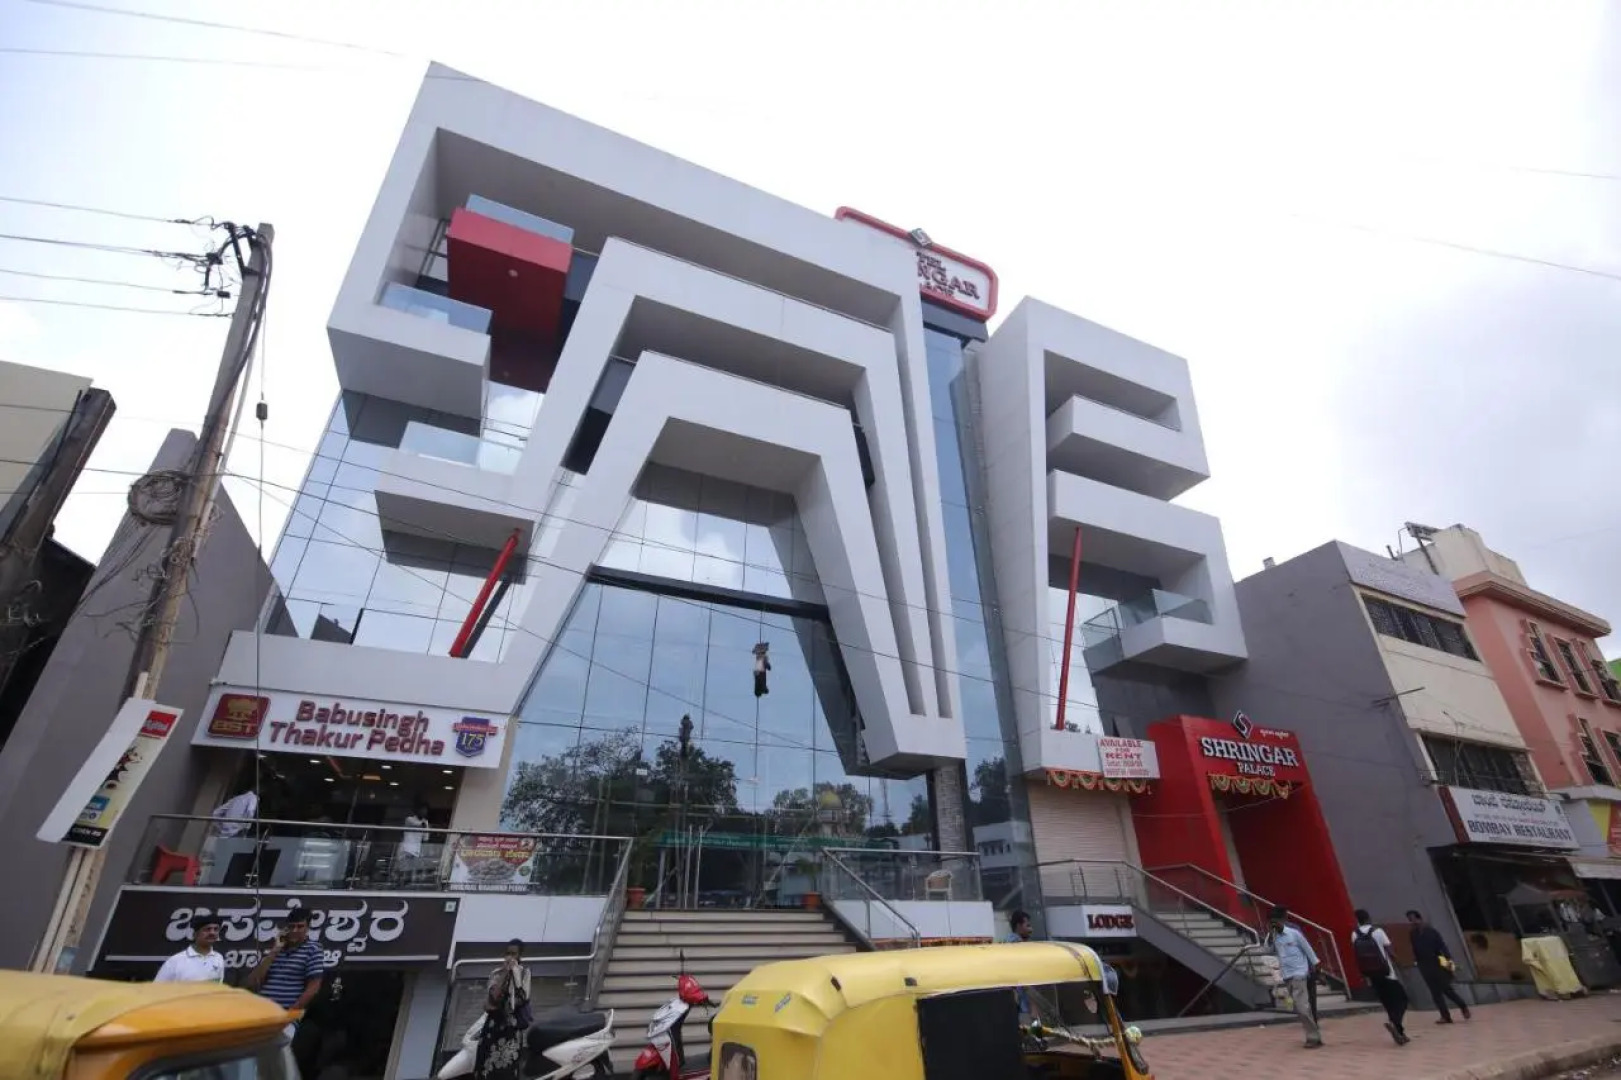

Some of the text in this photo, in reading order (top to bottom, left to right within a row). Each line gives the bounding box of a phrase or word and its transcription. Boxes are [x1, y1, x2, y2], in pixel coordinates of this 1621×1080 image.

[296, 700, 430, 738] Babusingh
[270, 721, 364, 749] Thakur
[366, 728, 446, 756] Pedha
[461, 731, 485, 748] 175
[1100, 738, 1144, 749] AVAILABLE
[1104, 752, 1143, 760] RENT
[1200, 736, 1300, 767] SHRINGAR
[1236, 761, 1276, 777] PALACE
[1467, 819, 1513, 836] BOMBAY
[1087, 913, 1135, 930] LODGE
